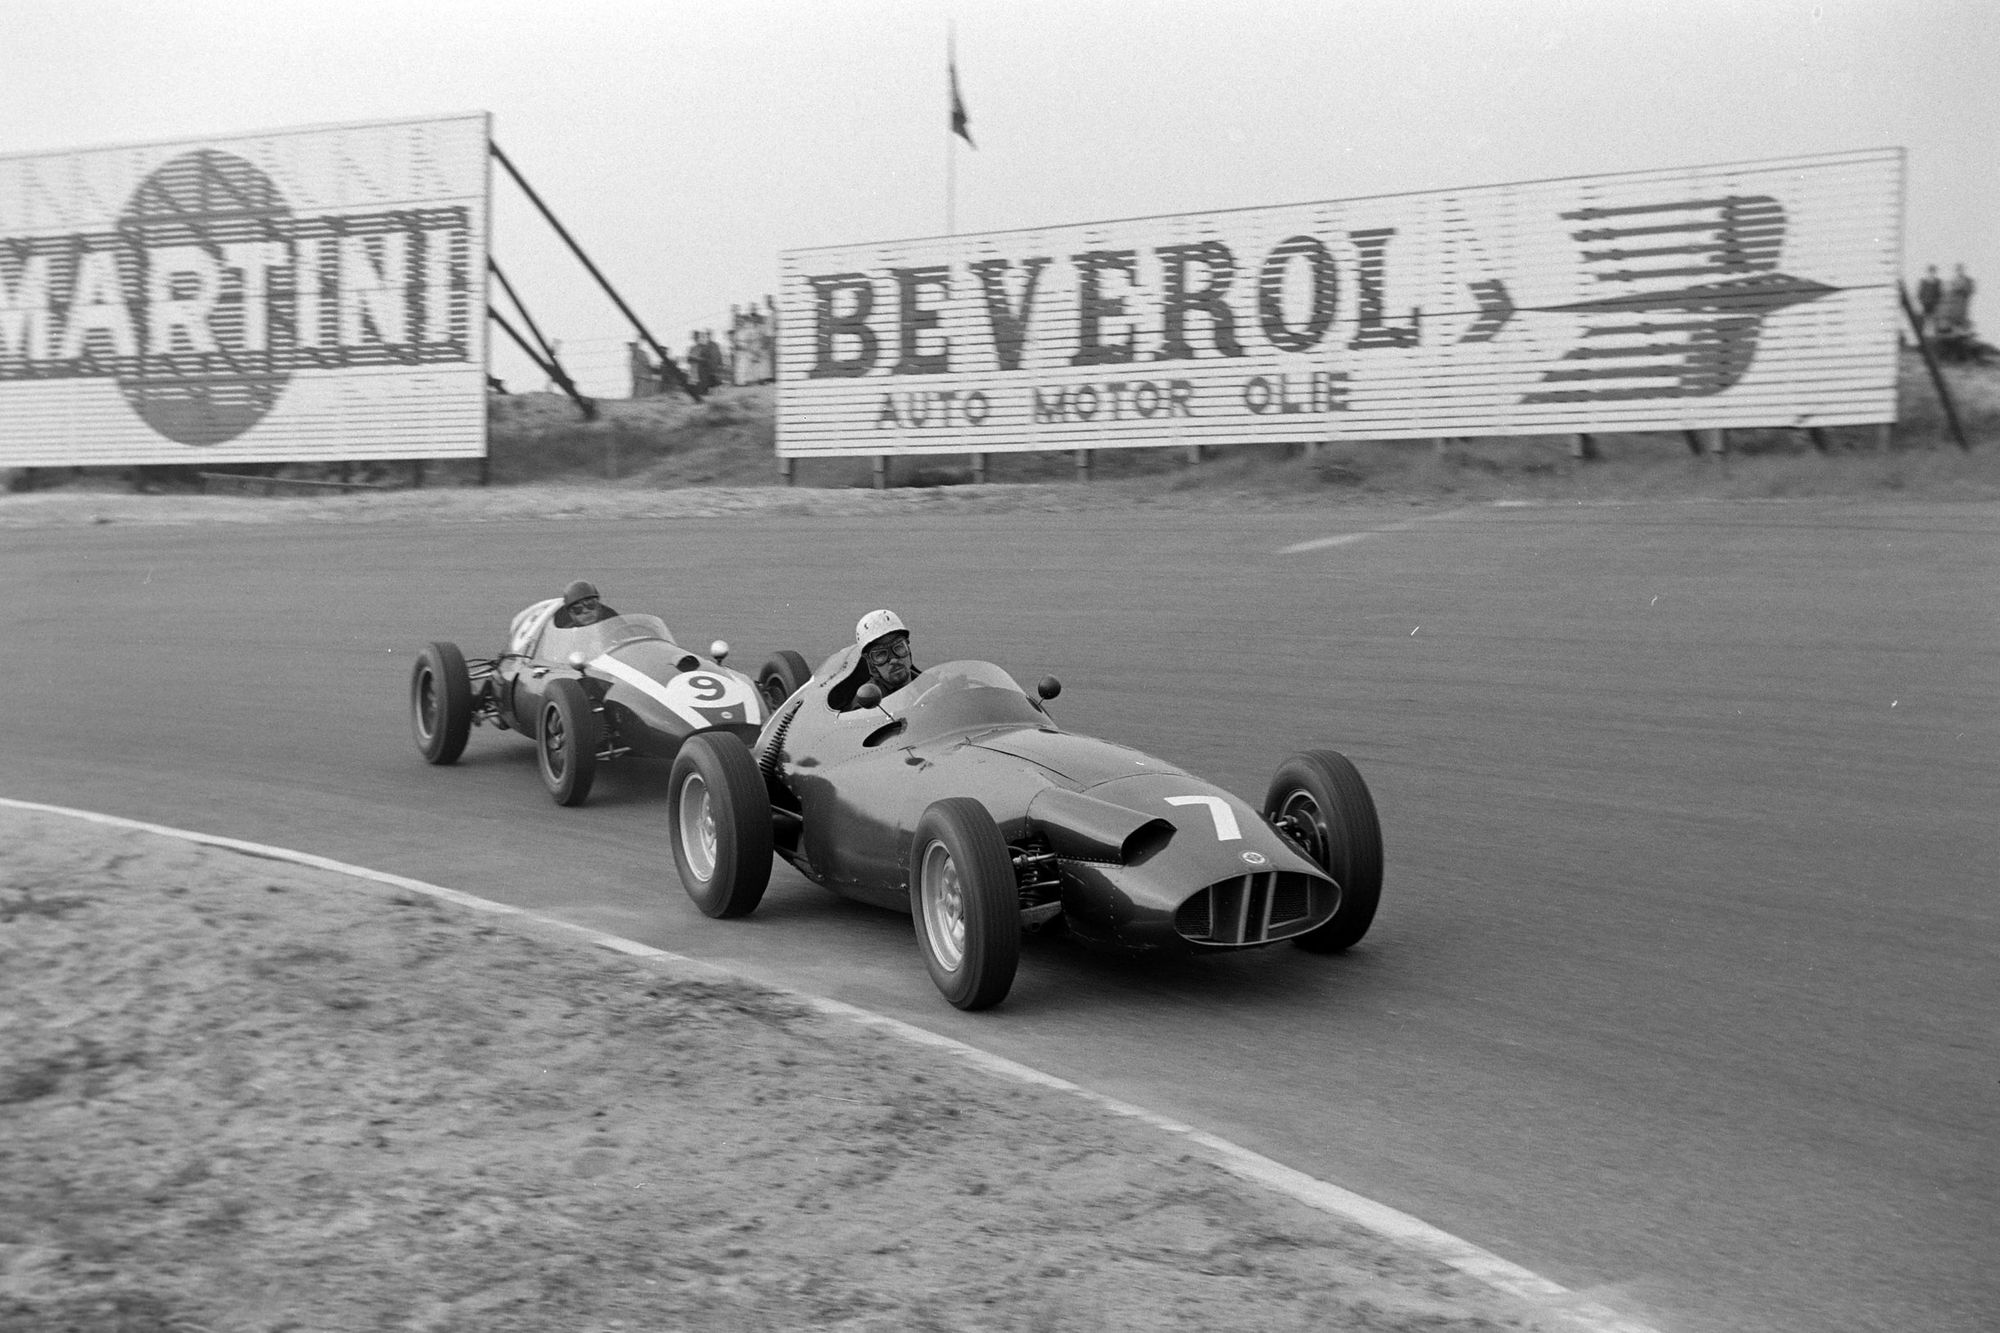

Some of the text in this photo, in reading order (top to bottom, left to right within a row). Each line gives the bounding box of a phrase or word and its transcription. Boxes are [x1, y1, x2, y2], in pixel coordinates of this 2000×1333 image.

[0, 231, 452, 359] MARTINI
[808, 228, 1420, 379] BEVEROL
[877, 371, 1350, 430] AUTO MOTOR OLIE
[688, 675, 726, 701] 9
[1163, 795, 1242, 841] 7
